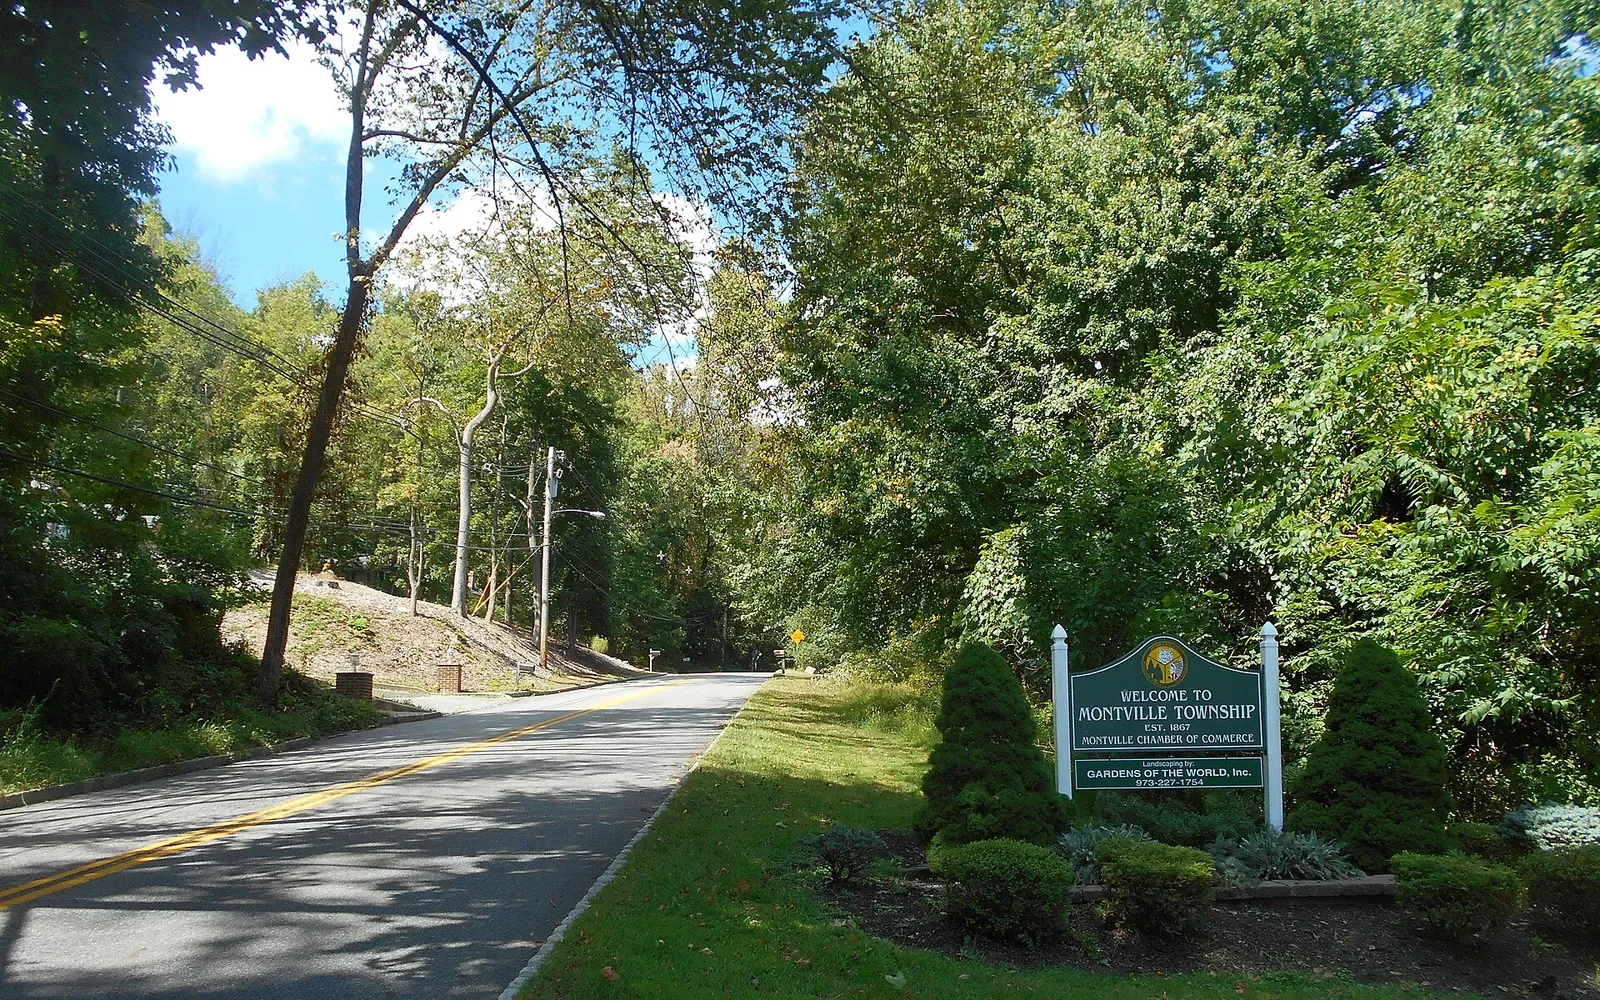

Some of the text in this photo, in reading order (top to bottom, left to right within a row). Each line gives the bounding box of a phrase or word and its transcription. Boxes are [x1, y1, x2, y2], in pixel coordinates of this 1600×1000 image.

[1121, 690, 1212, 702] WELCOME TO
[1079, 705, 1255, 721] MONTVILLE TOWNSHIP
[1145, 724, 1165, 732] EST.
[1082, 734, 1254, 745] MONTVILLE CHAMBER OF COMMERCE
[1087, 768, 1251, 778] GARDENS OF THE WORLD, Inc.
